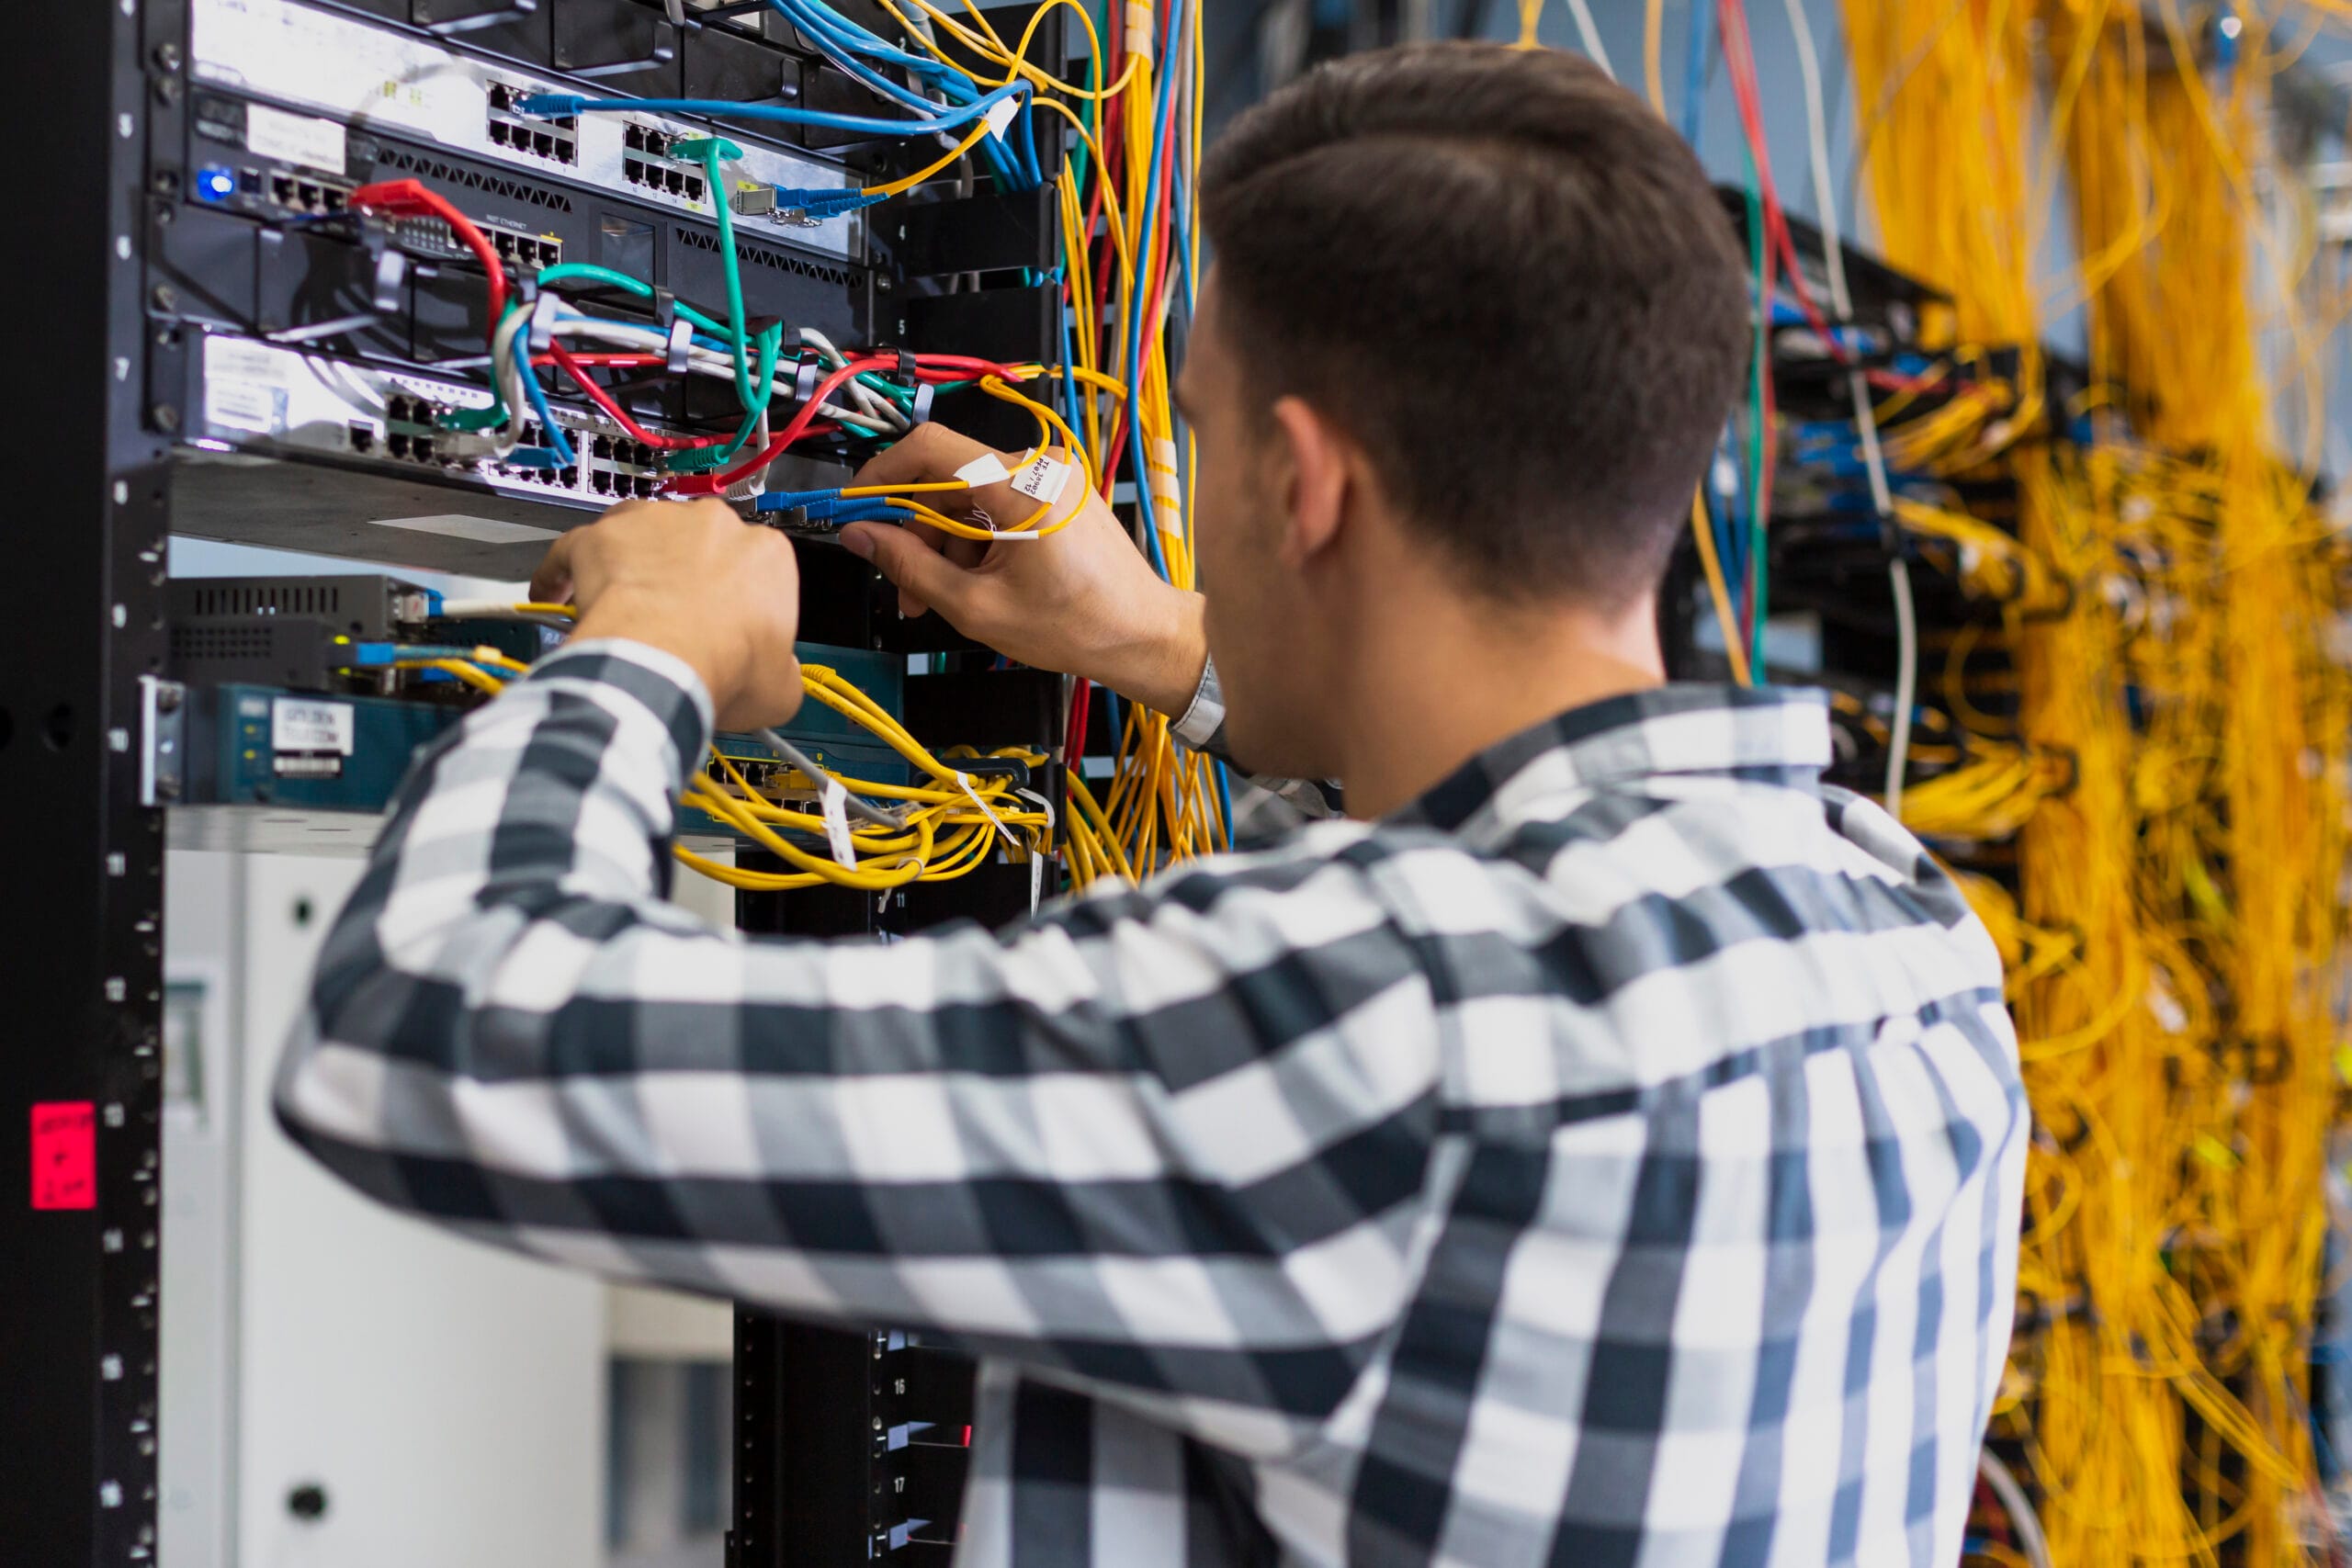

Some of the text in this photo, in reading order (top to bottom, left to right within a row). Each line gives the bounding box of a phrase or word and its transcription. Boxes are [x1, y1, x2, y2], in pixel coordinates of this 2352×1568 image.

[899, 225, 906, 241] 4
[899, 319, 905, 335] 5
[1042, 461, 1050, 471] TF
[1024, 484, 1032, 492] 12
[896, 892, 905, 908] 11
[894, 1380, 905, 1394] 16
[894, 1477, 905, 1493] 17
